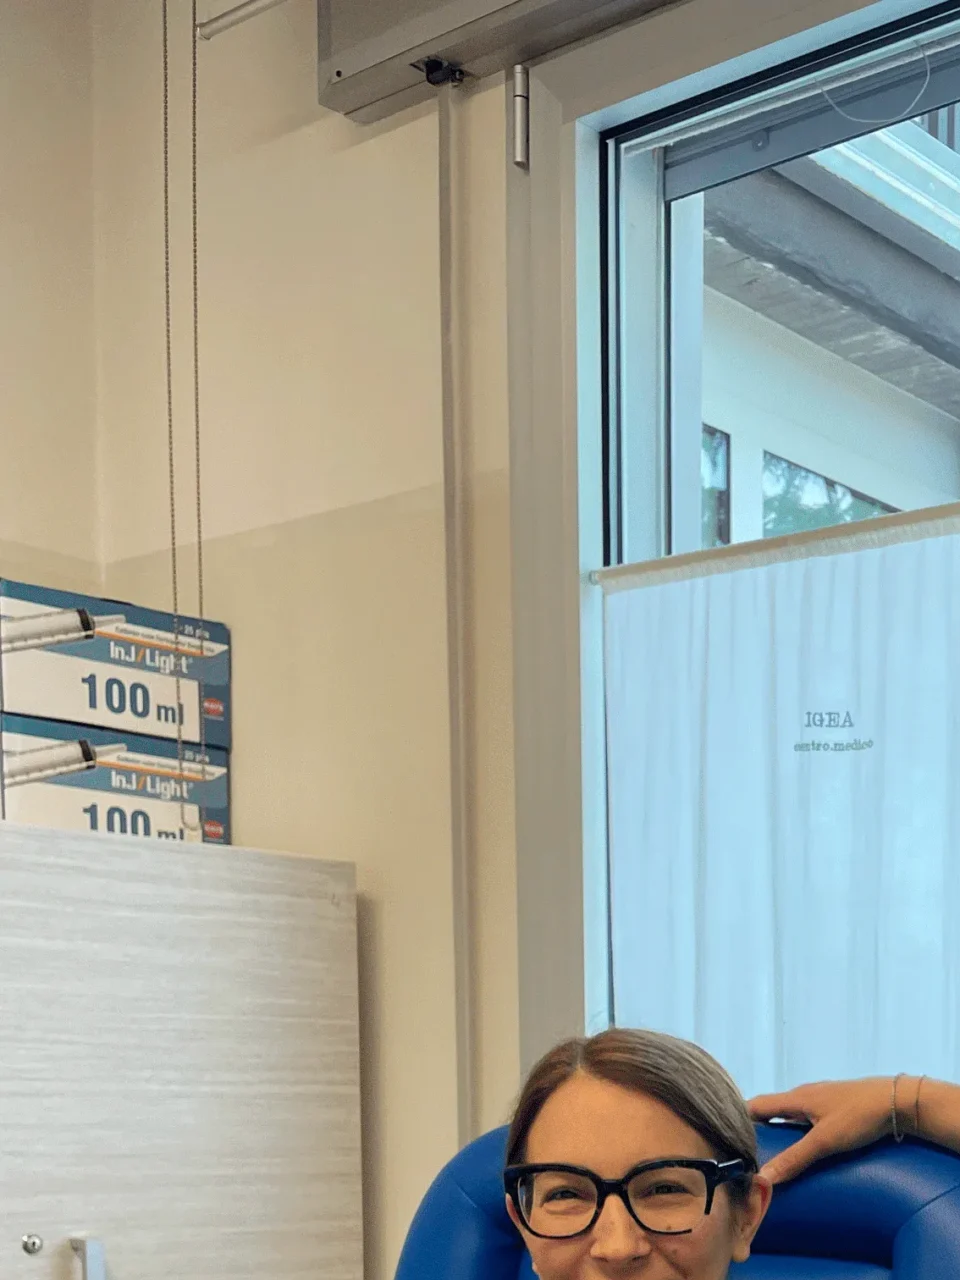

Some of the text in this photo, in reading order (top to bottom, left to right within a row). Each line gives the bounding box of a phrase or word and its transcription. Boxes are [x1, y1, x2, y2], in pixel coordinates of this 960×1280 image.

[81, 673, 184, 726] 100 ml
[804, 711, 854, 728] IGEA
